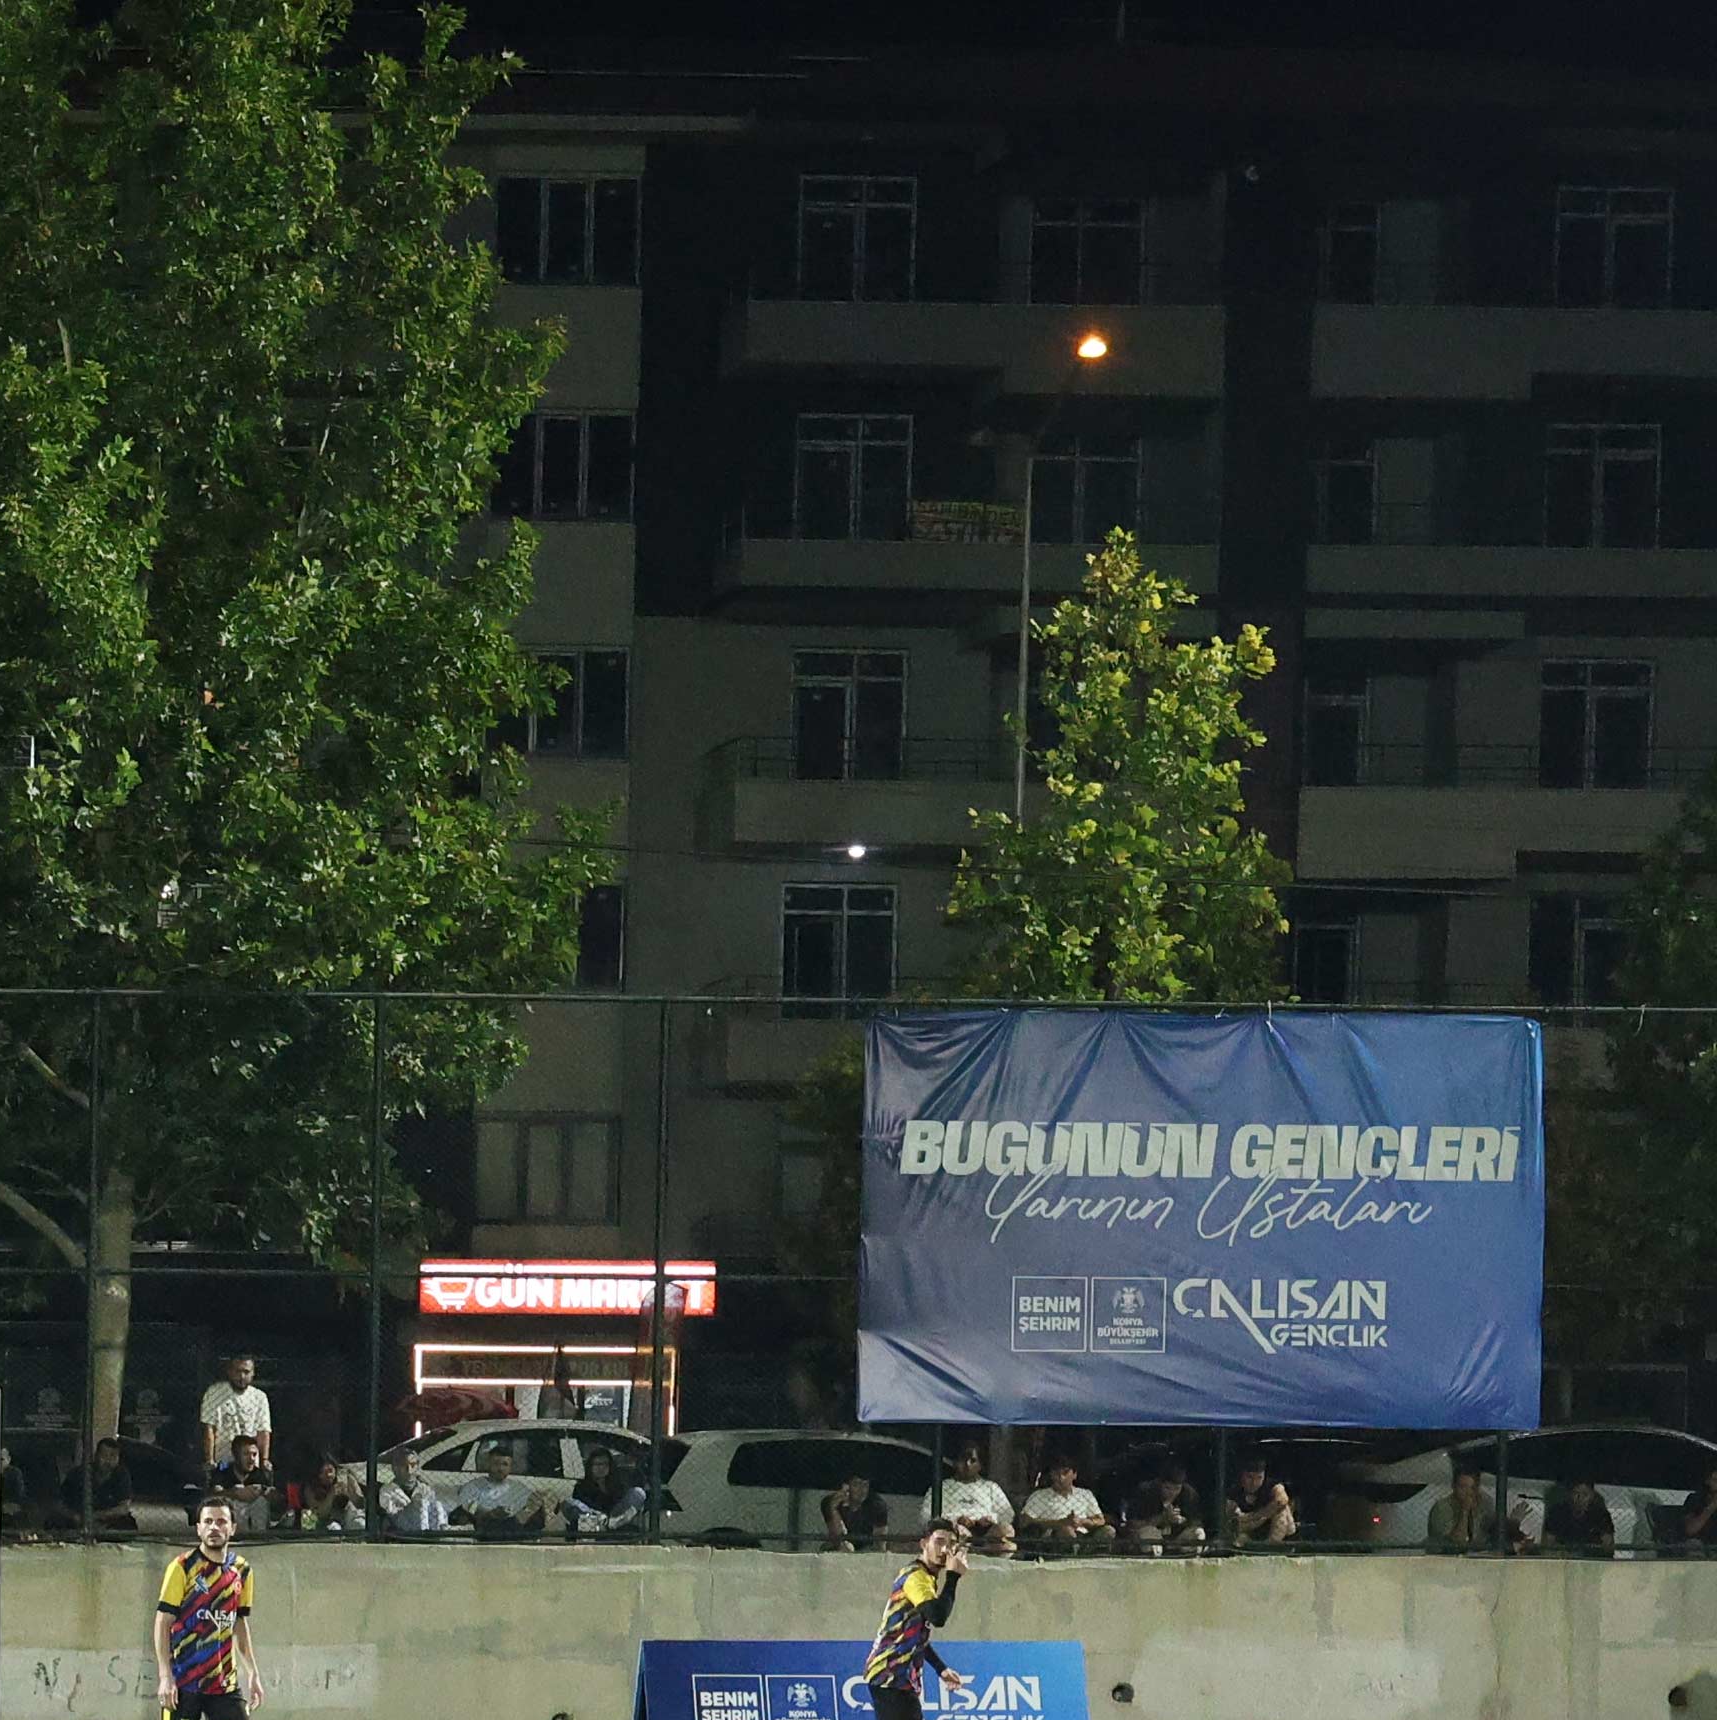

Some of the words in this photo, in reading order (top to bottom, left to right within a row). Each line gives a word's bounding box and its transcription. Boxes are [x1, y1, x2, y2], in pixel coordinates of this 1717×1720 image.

[475, 1263, 554, 1308] GÜN
[560, 1277, 708, 1309] MART
[700, 1691, 758, 1707] BENİM
